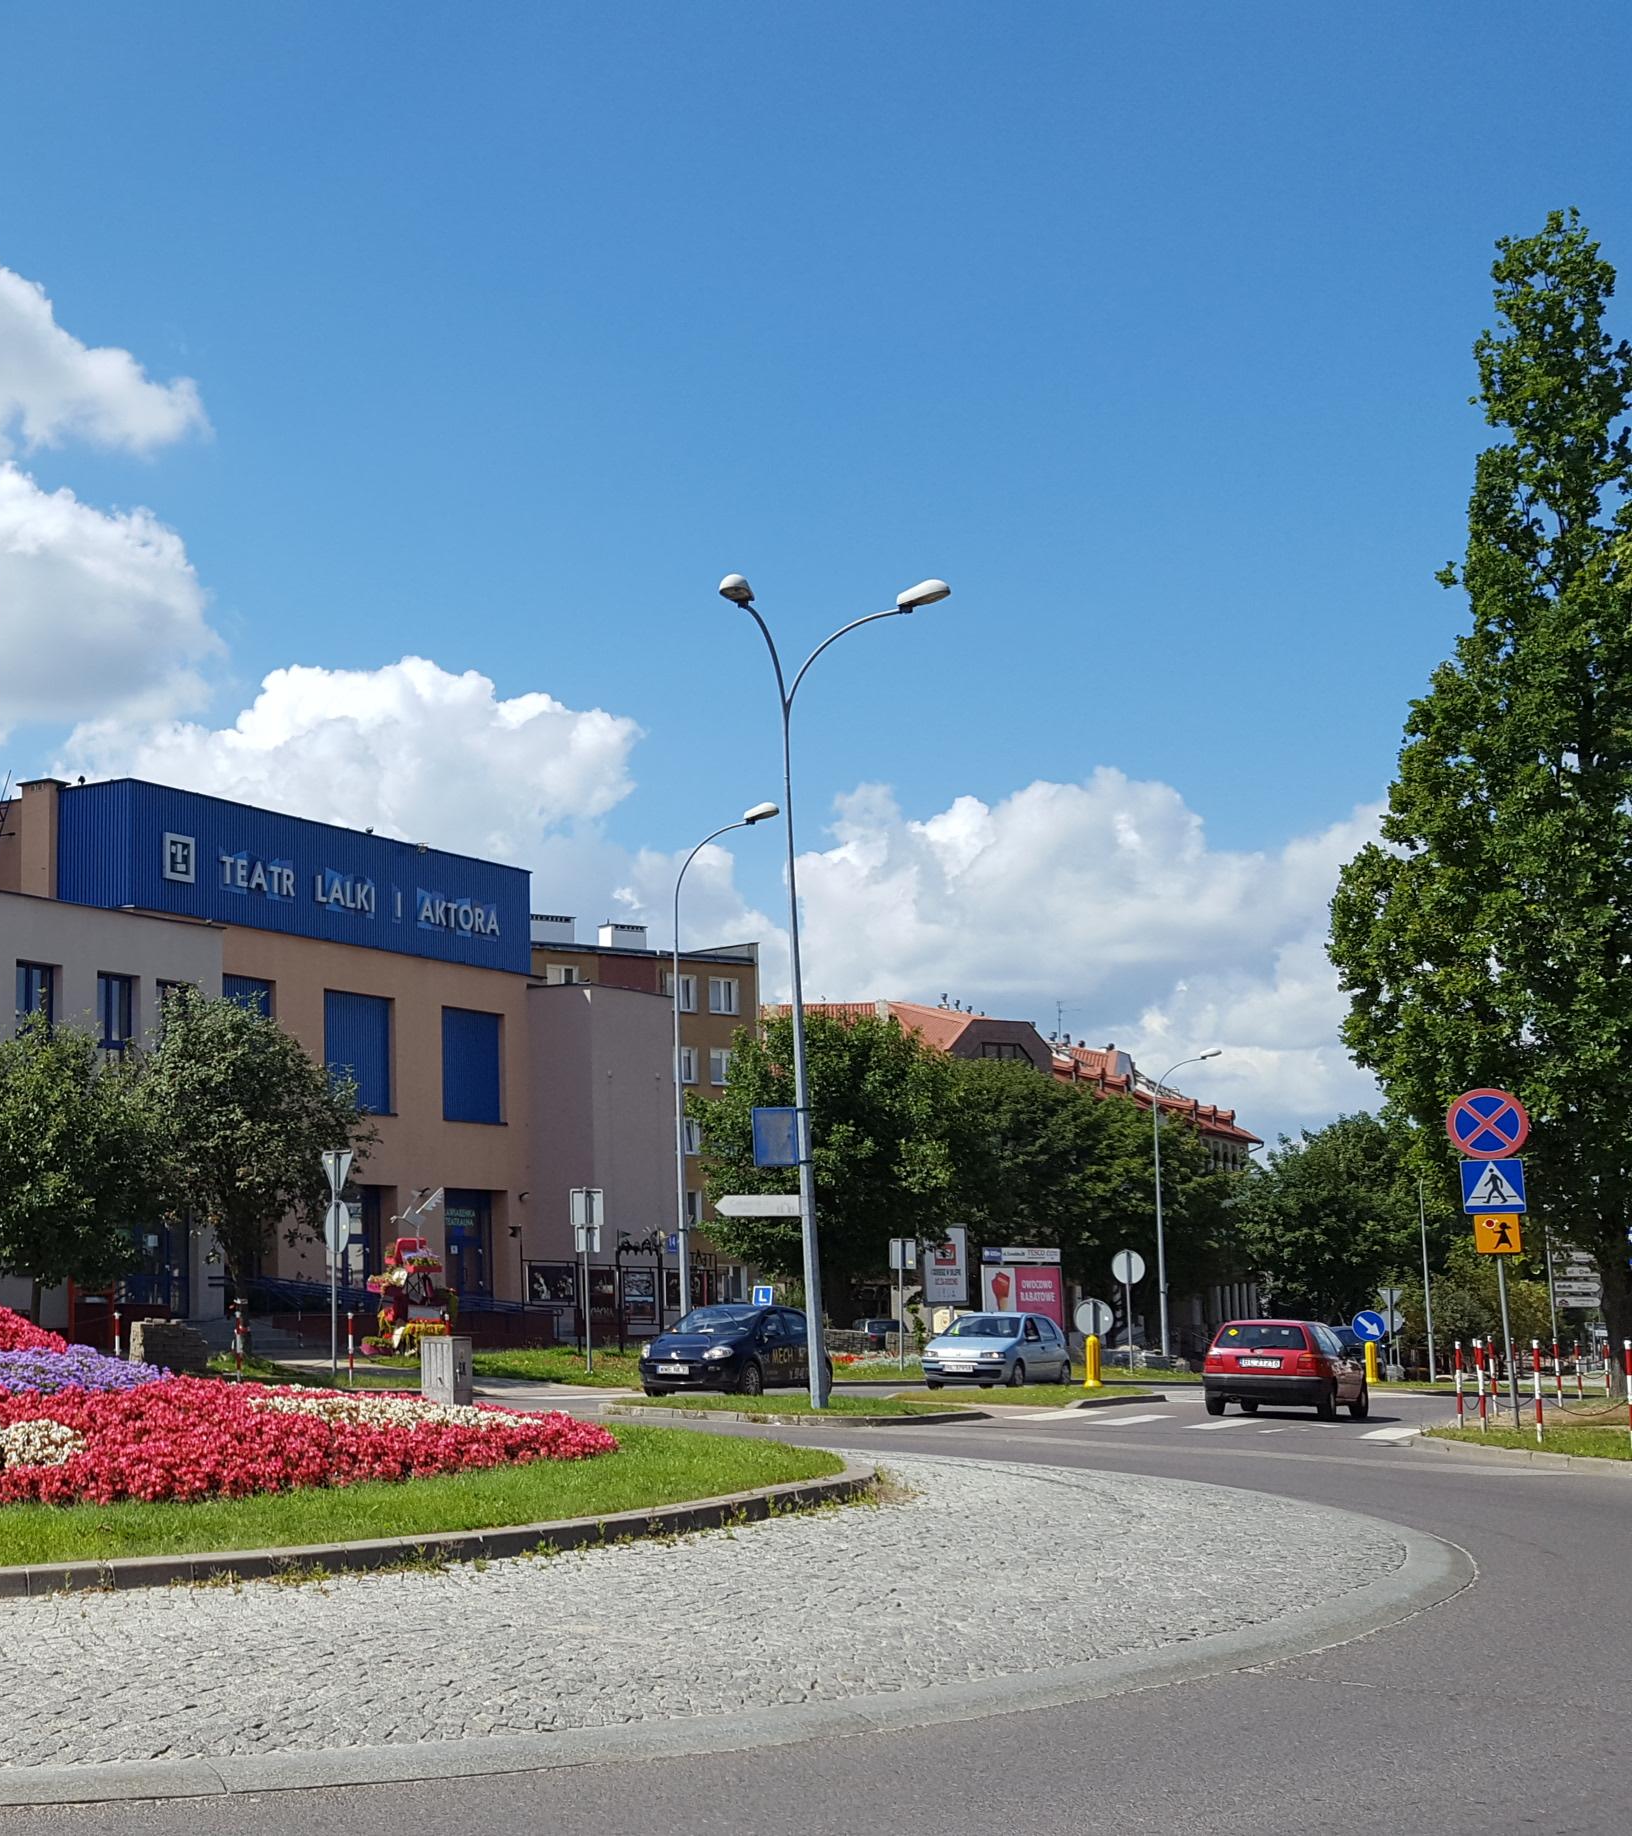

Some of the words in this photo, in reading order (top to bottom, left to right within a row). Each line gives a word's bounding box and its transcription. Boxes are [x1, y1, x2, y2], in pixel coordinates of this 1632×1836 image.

[220, 855, 295, 897] TEATR
[315, 874, 375, 914] LALKI
[395, 892, 402, 918] I
[418, 900, 500, 936] AKTORA
[759, 1289, 768, 1301] L
